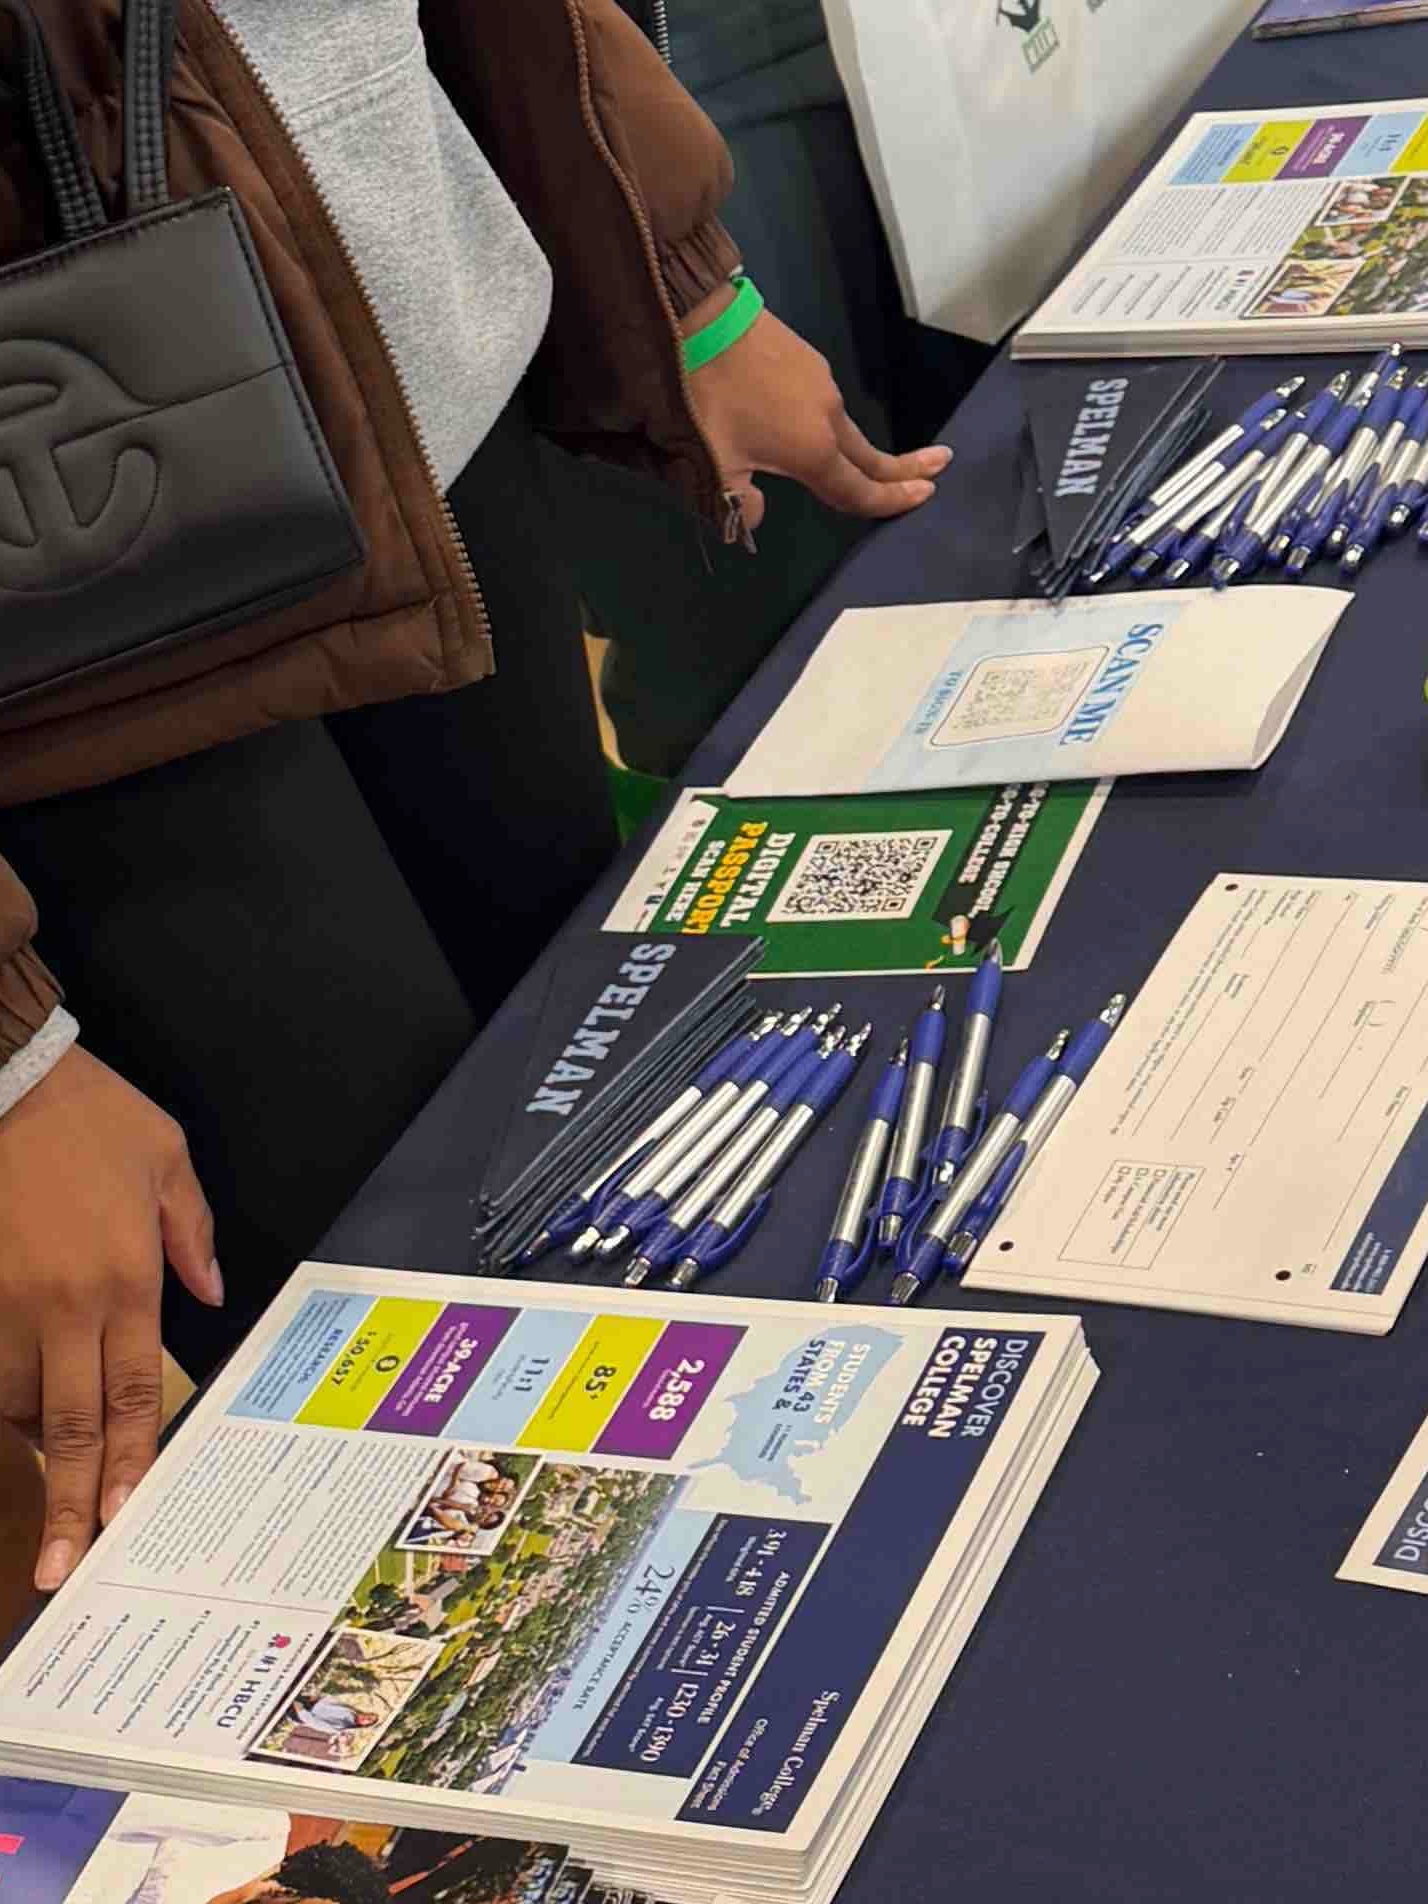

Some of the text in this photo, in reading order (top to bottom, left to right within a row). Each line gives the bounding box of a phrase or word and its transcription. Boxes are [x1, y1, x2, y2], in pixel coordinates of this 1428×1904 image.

[1055, 377, 1130, 497] SPELMAN
[1059, 623, 1163, 745] SCAN ME
[690, 840, 725, 877] SCAN
[719, 832, 796, 926] DIGITAL
[525, 942, 677, 1117] SPELMAN
[423, 1338, 478, 1402] 39-ACRE
[513, 1358, 549, 1391] 11:1
[648, 1358, 704, 1420] 2,588
[771, 1398, 791, 1409] &
[783, 1339, 825, 1392] STATES
[792, 1339, 845, 1411] FROM 43
[813, 1343, 870, 1423] STUDENTS
[901, 1335, 966, 1425] COLLEGE
[927, 1337, 997, 1437] SPELMAN
[960, 1339, 1028, 1436] DISCOVER
[572, 1564, 675, 1709] 24% ACCEPTANCE RATE
[695, 1620, 736, 1665] 26 31
[697, 1571, 789, 1722] ADMITTED STUDENT PROFILE
[216, 1655, 277, 1727] #1 HBCU
[791, 1690, 839, 1752] Spelman
